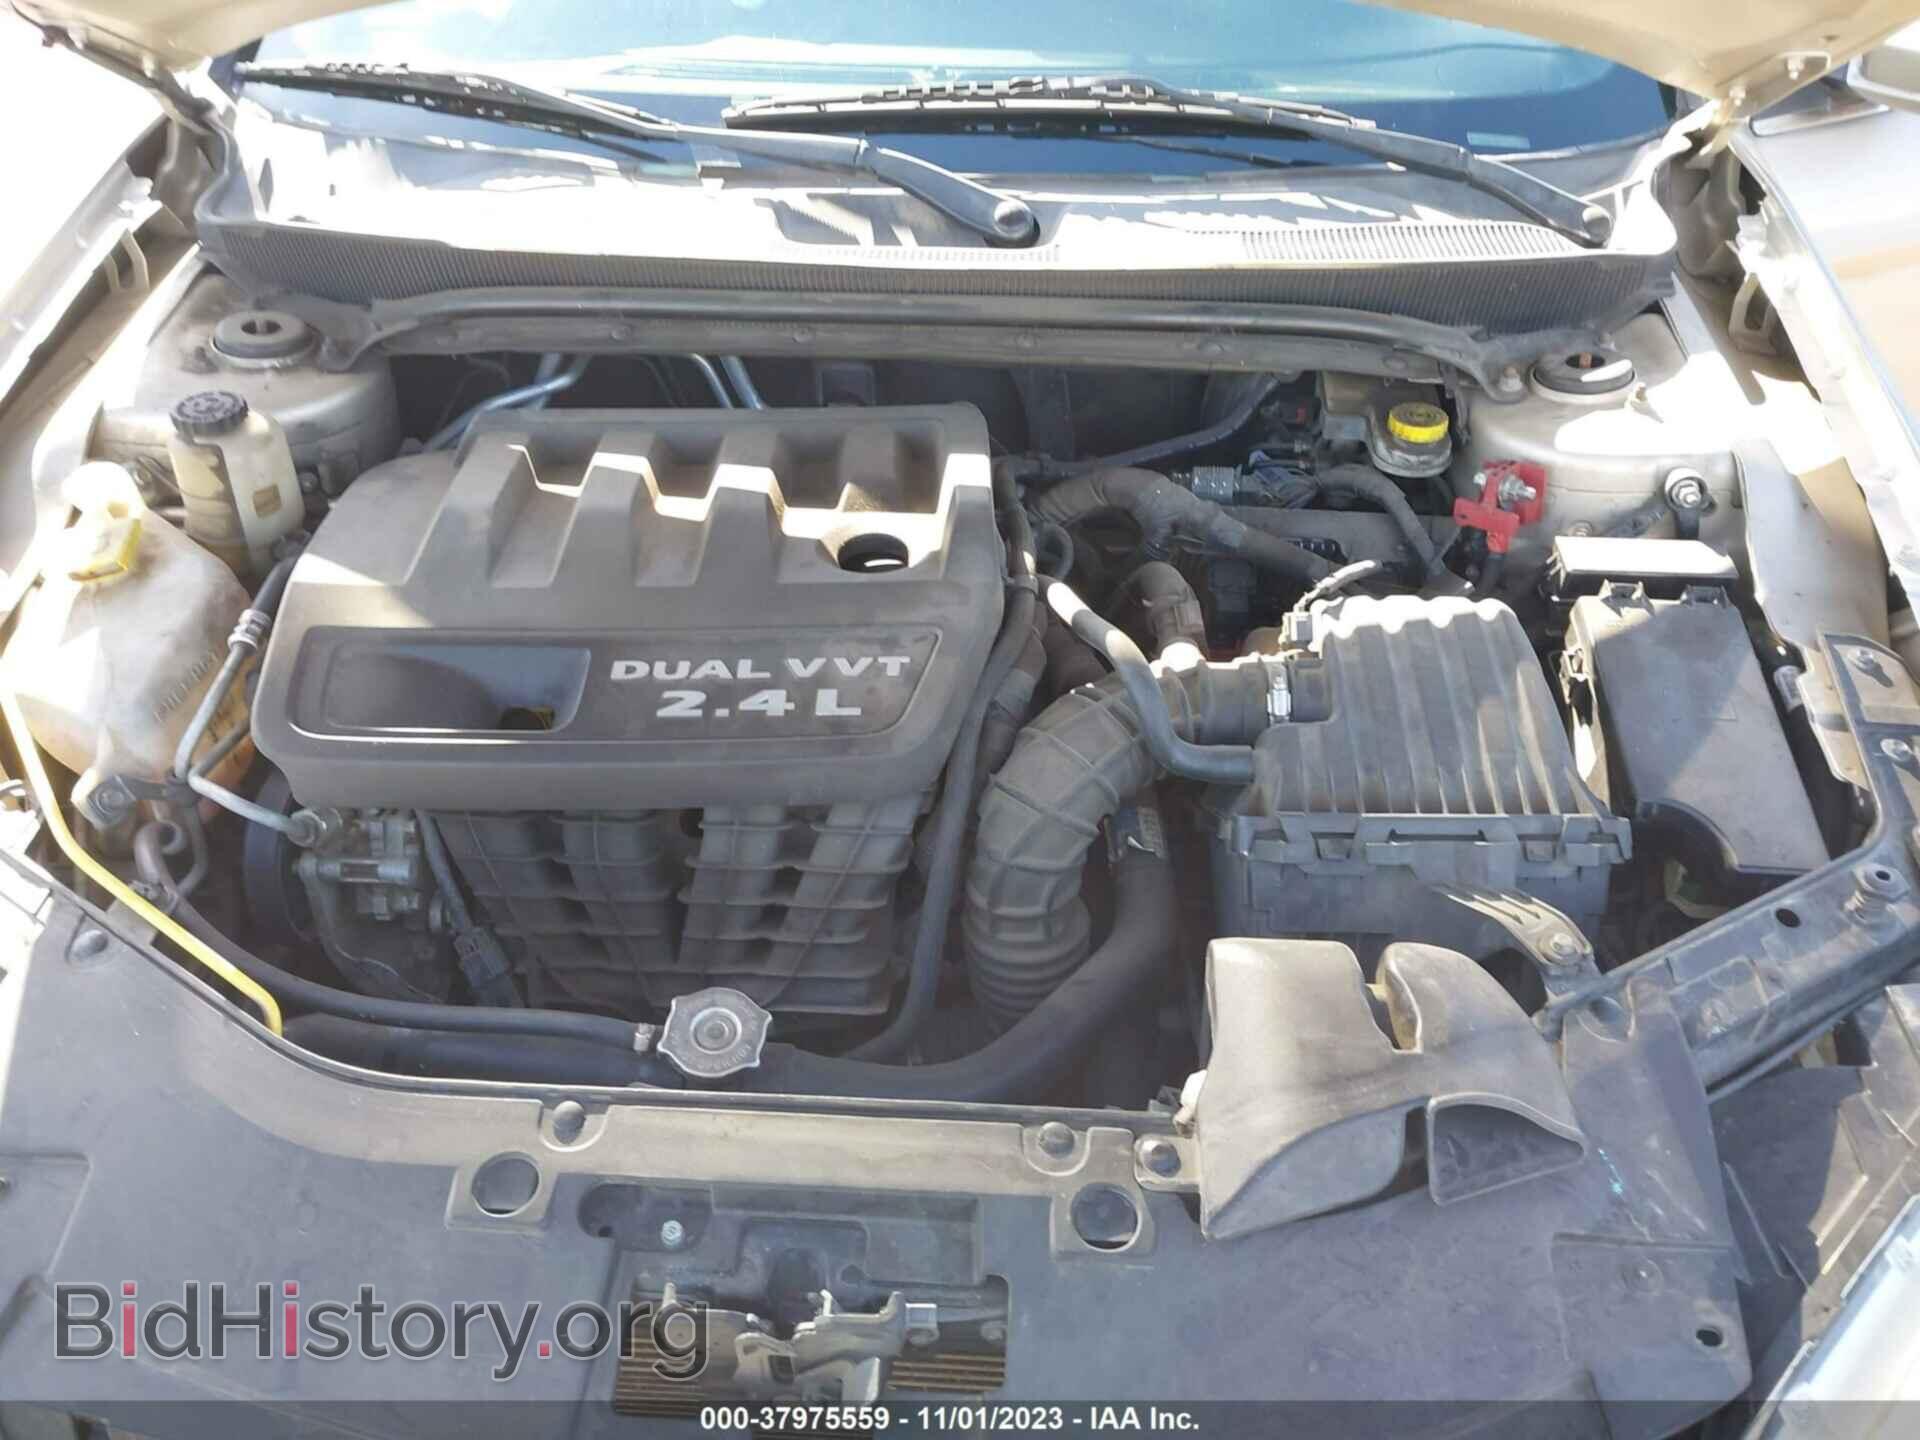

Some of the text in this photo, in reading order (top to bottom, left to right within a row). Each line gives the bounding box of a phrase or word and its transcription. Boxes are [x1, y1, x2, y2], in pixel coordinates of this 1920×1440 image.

[610, 655, 912, 681] DUAL VVT
[656, 688, 862, 718] 2.4 L
